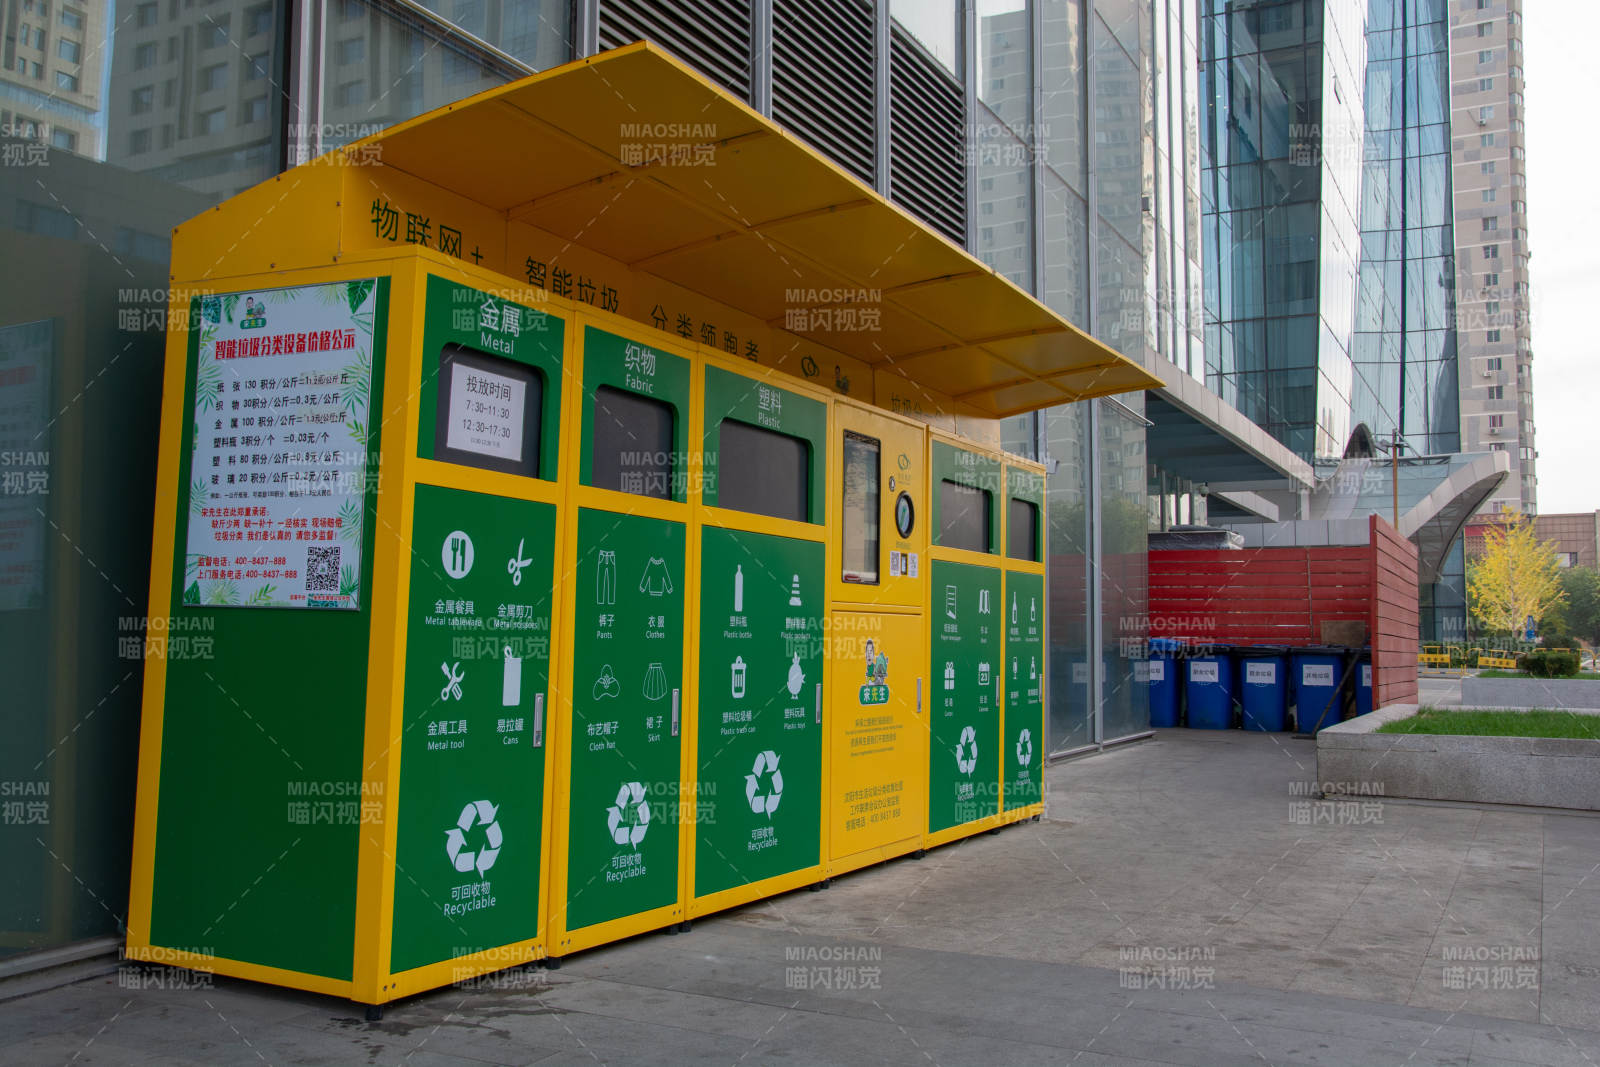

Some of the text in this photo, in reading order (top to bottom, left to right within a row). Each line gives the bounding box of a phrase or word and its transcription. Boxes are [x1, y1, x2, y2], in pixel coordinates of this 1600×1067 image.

[479, 298, 521, 338] 金属
[215, 328, 356, 361] 智能垃圾分类设备价格公示
[480, 331, 515, 355] Metal
[624, 342, 656, 377] 织物
[466, 374, 512, 403] 投放时间
[624, 373, 654, 394] Fabric
[758, 386, 782, 414] 塑料
[466, 399, 510, 420] 7:30-11:30
[462, 418, 511, 439] 12:30-17:30
[758, 411, 781, 430] Plastic
[211, 519, 240, 529] 缺斤少两
[277, 518, 308, 528] 一经核实
[311, 518, 343, 528] 现场赔偿
[214, 531, 243, 541] 垃圾分类
[247, 531, 292, 541] 我们是认真的
[434, 599, 475, 616] 金属餐具
[497, 603, 533, 619] 金属剪刀
[425, 615, 446, 626] Metal
[598, 613, 615, 628] 裤子
[596, 630, 613, 639] Pants
[645, 630, 665, 639] Clothes
[863, 687, 886, 702] 宋先生
[427, 719, 468, 736] 金属工具
[496, 718, 525, 733] 易拉罐
[427, 739, 465, 751] Metal tool
[502, 736, 519, 745] Cans
[589, 742, 605, 752] Cloth
[747, 837, 778, 853] Recyclable
[611, 852, 642, 869] 可回收物
[606, 864, 647, 883] Recyclable
[451, 880, 491, 901] 可回收物
[443, 895, 497, 917] Recyclable
